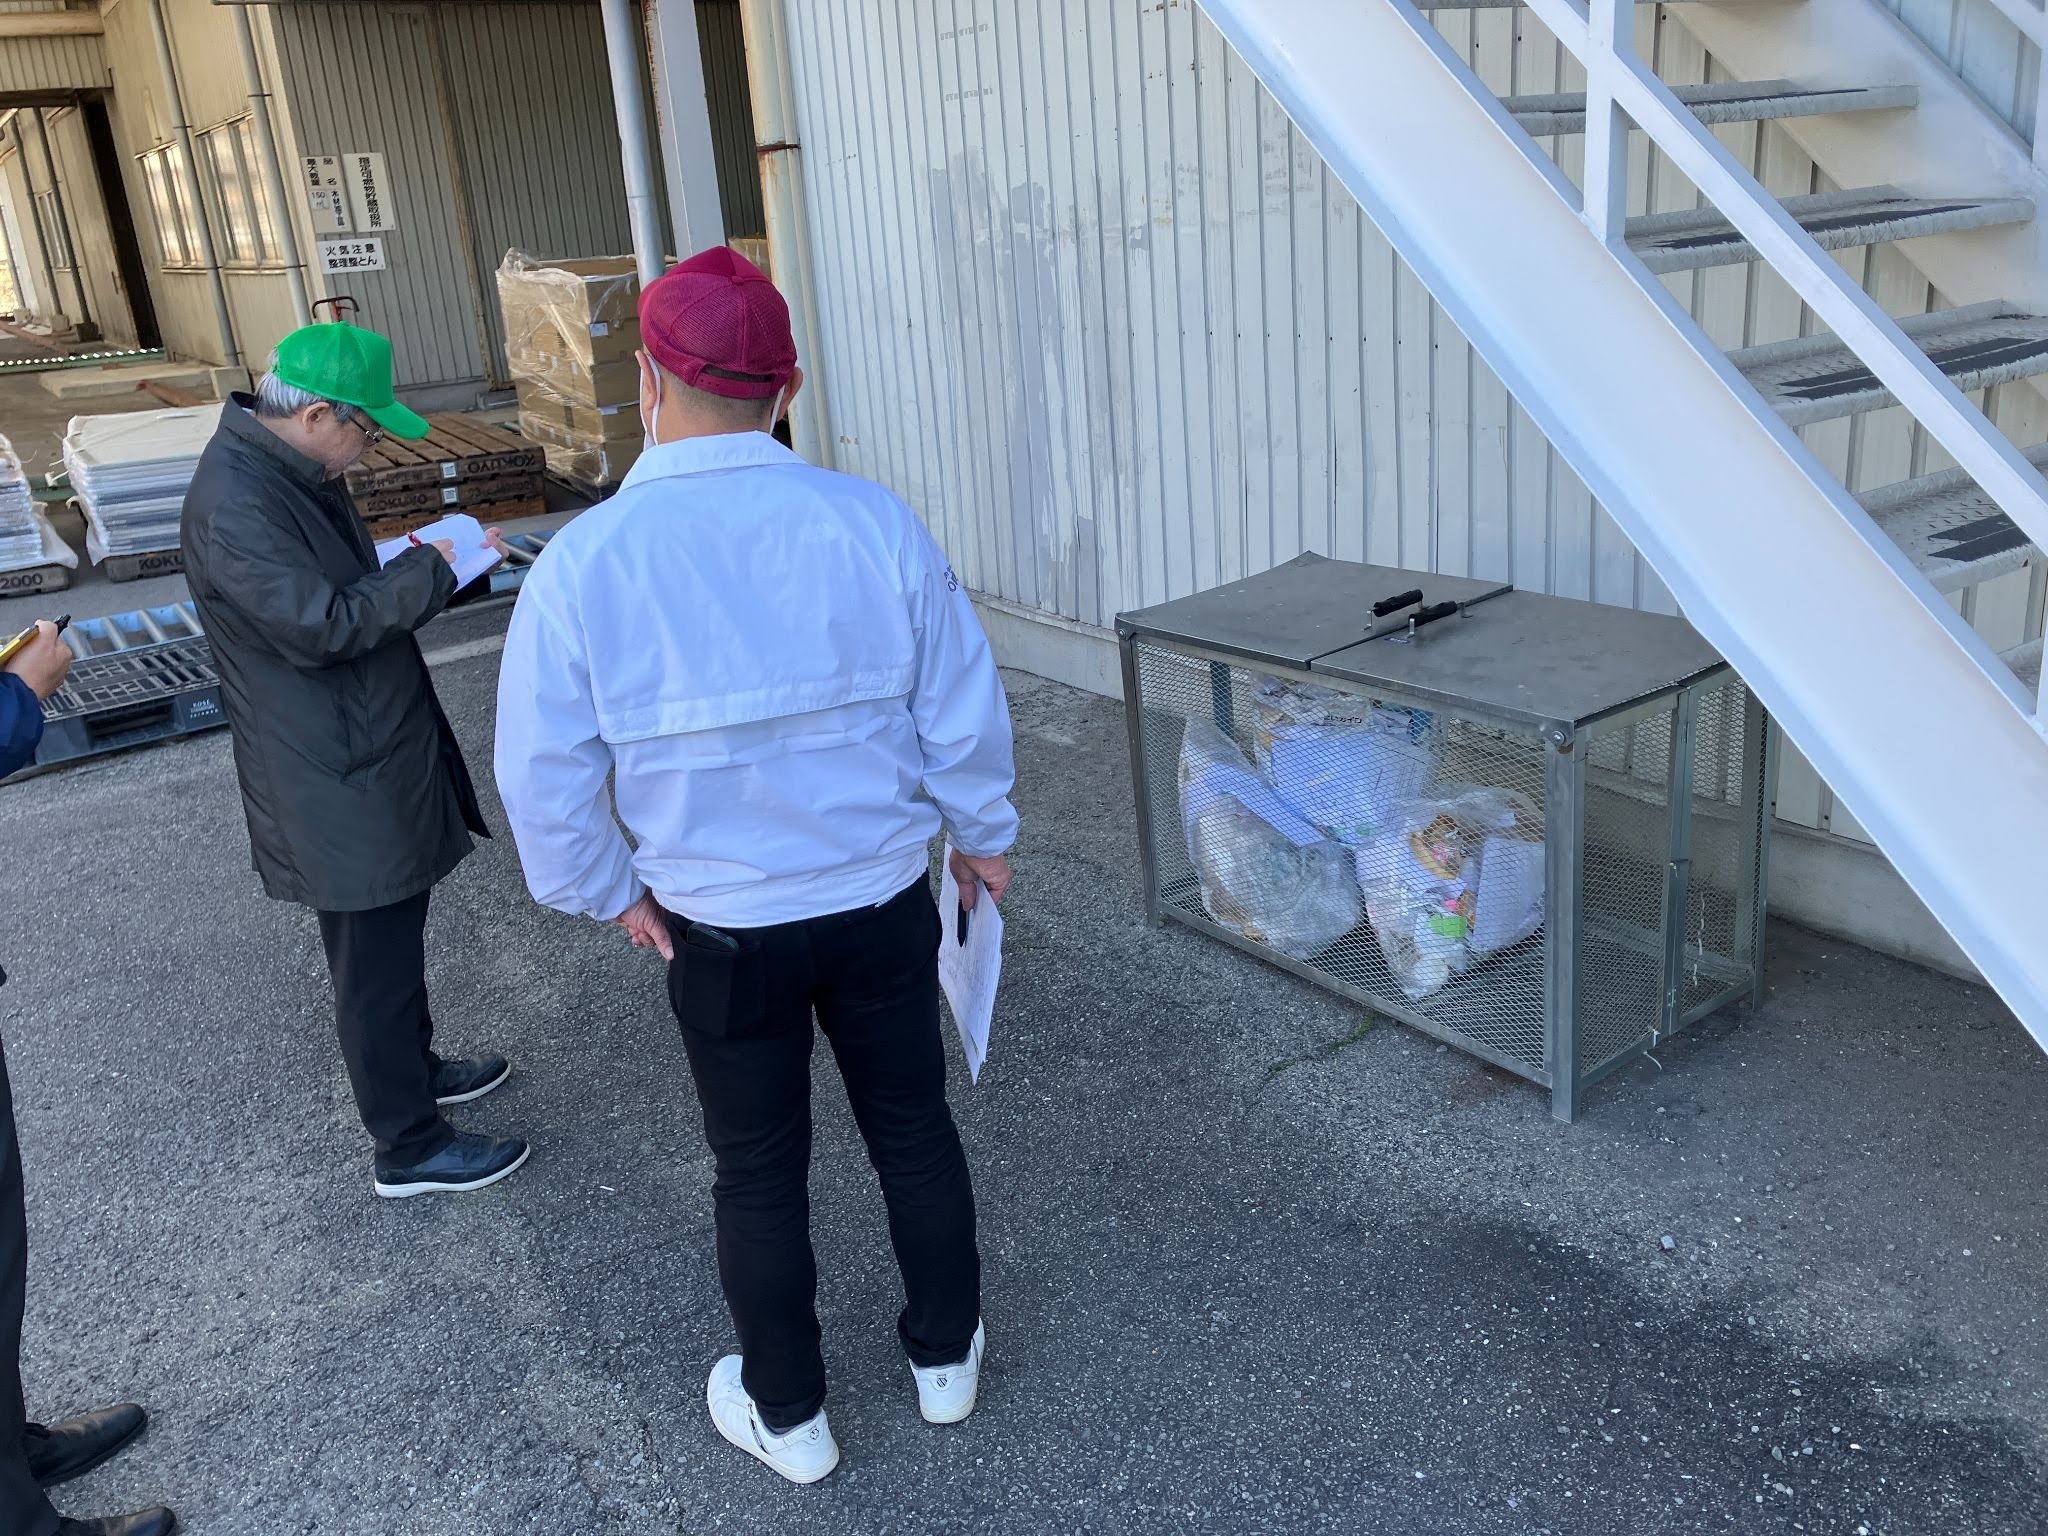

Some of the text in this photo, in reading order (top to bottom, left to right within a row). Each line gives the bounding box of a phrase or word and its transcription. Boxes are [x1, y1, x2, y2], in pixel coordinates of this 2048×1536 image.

[326, 243, 375, 256] 火気注意
[328, 256, 377, 269] 整理整とん
